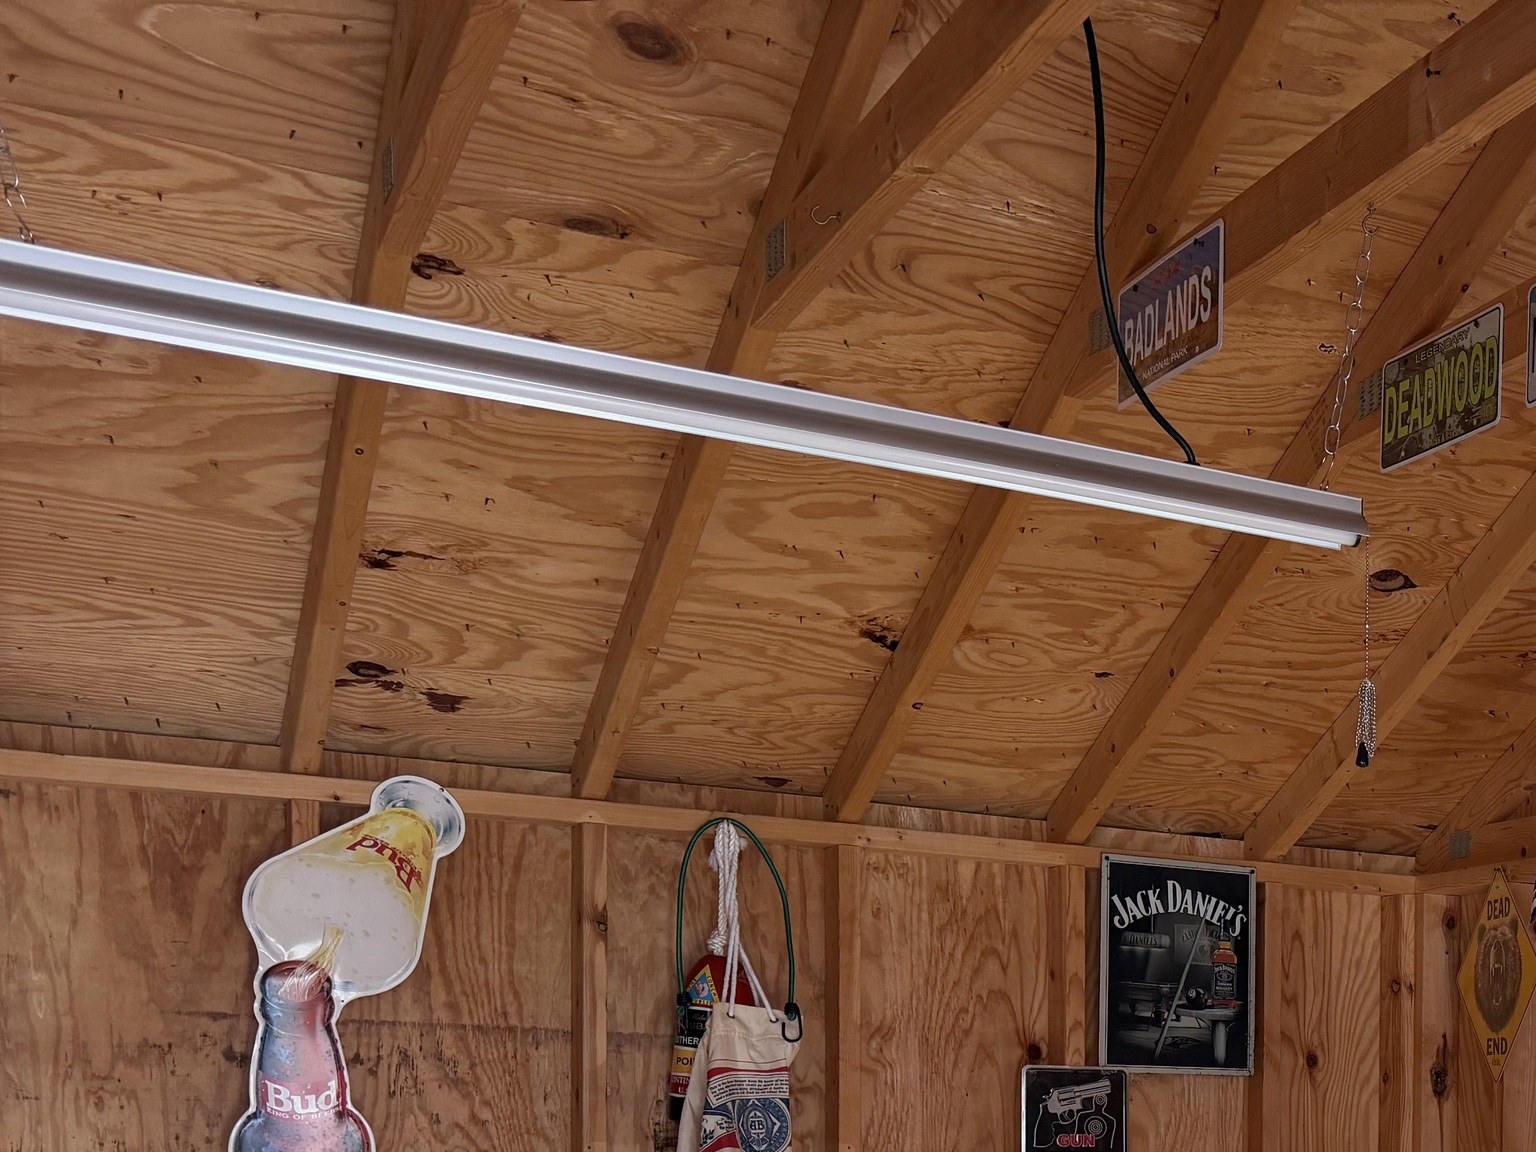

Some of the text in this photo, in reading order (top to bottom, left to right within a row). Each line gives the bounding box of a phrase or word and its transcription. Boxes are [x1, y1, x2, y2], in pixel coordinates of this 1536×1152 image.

[1124, 265, 1213, 368] BADLANDS
[1170, 345, 1189, 364] PARK
[1414, 327, 1471, 364] LEGENDARY
[1383, 335, 1498, 445] DEADWOOD
[345, 836, 417, 894] Bud
[1110, 880, 1248, 938] JACK DANIEL'S
[1486, 896, 1511, 920] DEAD
[1486, 1037, 1508, 1056] END
[265, 1079, 339, 1115] Bud
[1056, 1133, 1096, 1147] GUN
